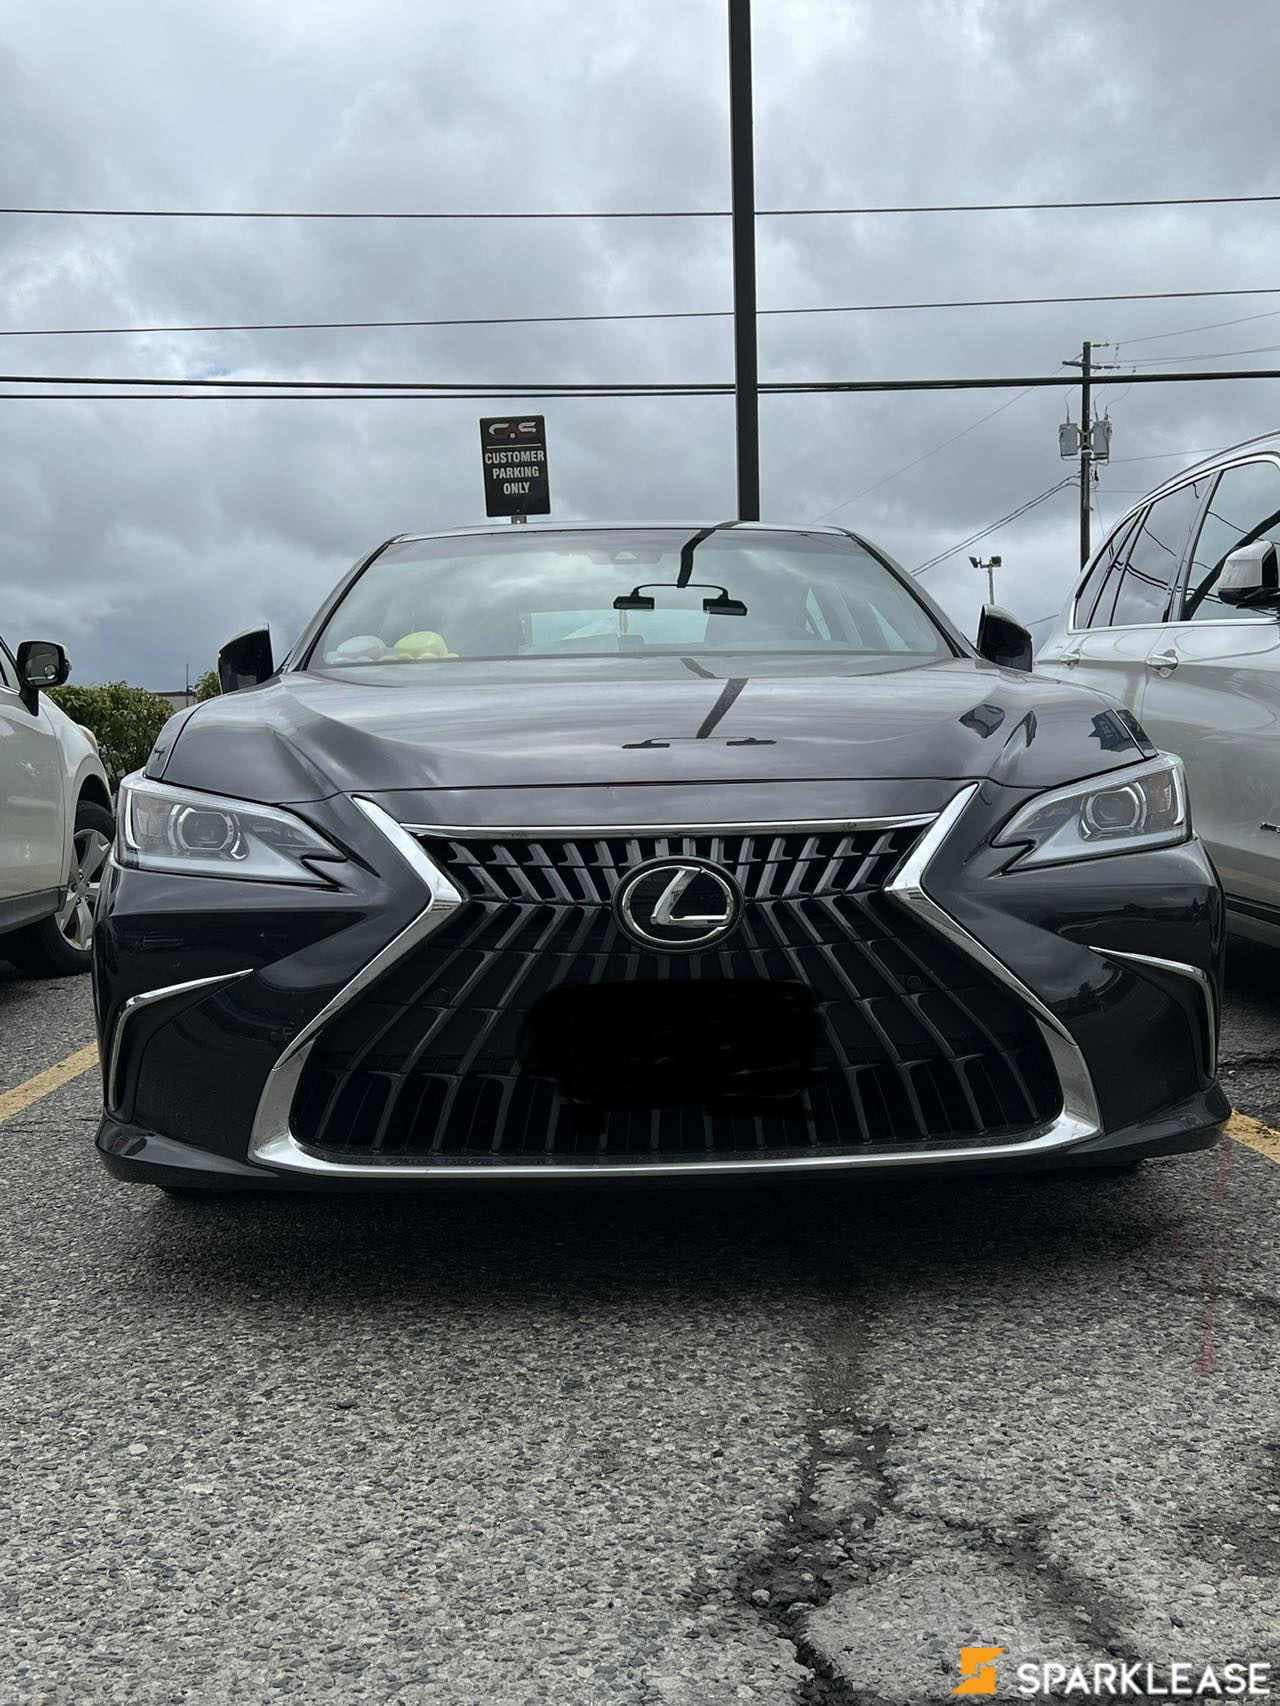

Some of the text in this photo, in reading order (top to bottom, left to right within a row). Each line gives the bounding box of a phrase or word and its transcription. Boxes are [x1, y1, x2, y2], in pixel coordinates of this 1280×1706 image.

[485, 451, 544, 464] CUSTOMER
[492, 466, 539, 479] PARKING
[503, 481, 530, 494] ONLY
